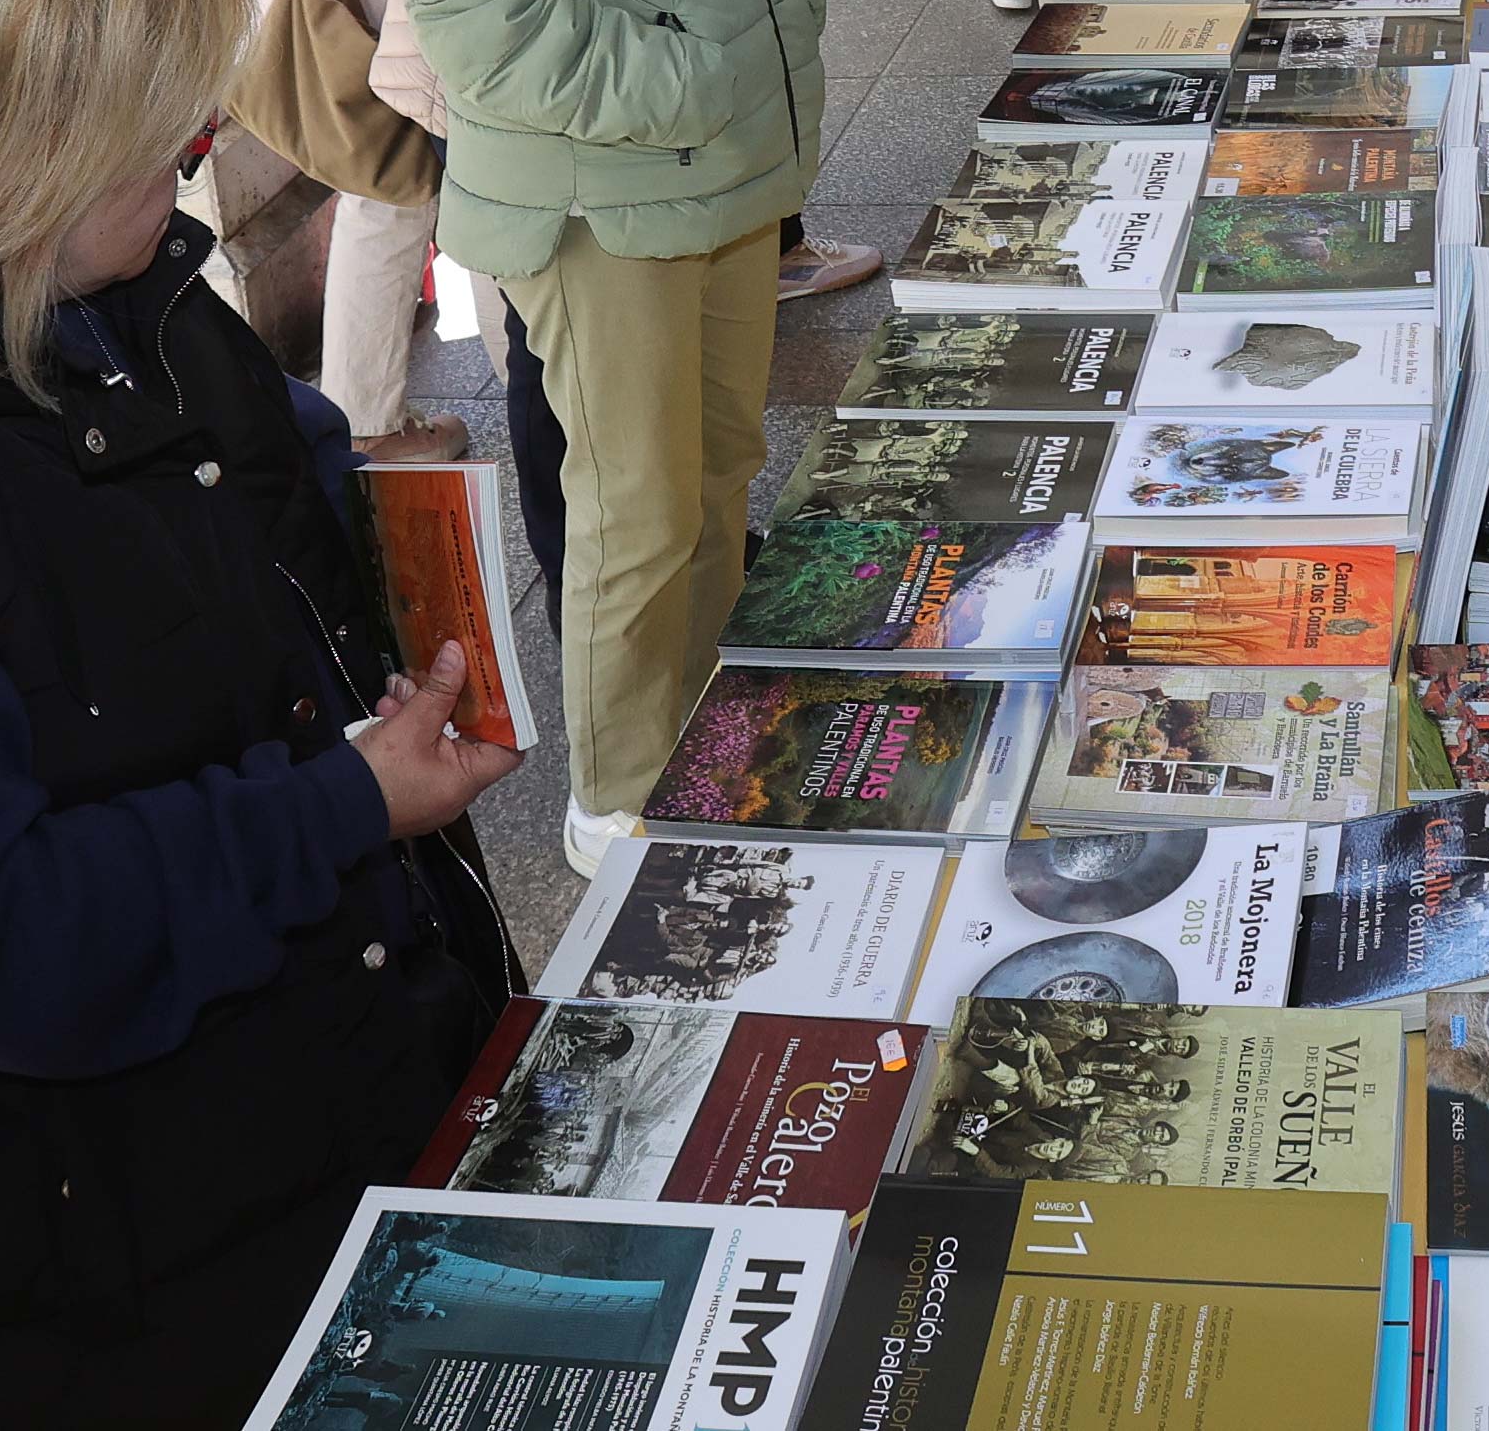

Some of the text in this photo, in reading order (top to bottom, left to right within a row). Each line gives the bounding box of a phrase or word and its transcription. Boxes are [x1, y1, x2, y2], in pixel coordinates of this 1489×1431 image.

[1171, 78, 1203, 116] EL CANAL
[1108, 212, 1151, 274] PALENCIA
[1069, 327, 1116, 393] PALENCIA
[1018, 436, 1071, 515] PALENCIA
[1331, 428, 1362, 501] DE LA CULEBRA
[1352, 428, 1391, 502] LA SIERRA
[884, 544, 924, 624] MONTAÑA PALENTINA
[900, 544, 937, 624] DE USO TRADICIONAL EN LA
[914, 543, 965, 625] PLANTAS
[1303, 561, 1331, 650] de los Condes
[1332, 561, 1354, 614] Carrión
[799, 701, 859, 797] PALENTINOS
[840, 704, 890, 798] DE USO TRADICIONAL EN
[843, 703, 875, 751] PÁRAMOS
[858, 705, 923, 800] PLANTAS
[1312, 718, 1340, 802] y La Braña
[1339, 701, 1366, 777] Santullán
[824, 760, 851, 798] VALLES
[1303, 845, 1319, 882] 10.80
[1424, 817, 1455, 917] Castillos
[826, 872, 880, 999] paréntesis tres (1936-1939)
[852, 869, 906, 989] DIARIO DE GUERRA
[1178, 898, 1207, 945] 2018
[1234, 842, 1280, 995] La Mojonera
[1355, 919, 1370, 962] Palentina
[1406, 870, 1437, 975] de ceniza
[461, 1095, 485, 1123] aruz
[729, 1037, 802, 1191] Historia de la minería en el Valle de
[807, 1057, 878, 1143] Pozo
[849, 1086, 871, 1102] El
[961, 1112, 976, 1136] aruz
[1200, 1035, 1230, 1175] JOSÉ SIERRA ÁLVAREZ FERNANDO
[1221, 1036, 1257, 1187] VALLEJO DE ORBÓ (PAL
[1245, 1035, 1275, 1173] HISTORIA DE LA COLONIA
[1272, 1045, 1321, 1190] DE LOS SUEÑ
[1317, 1036, 1361, 1148] VALLE
[1362, 1082, 1376, 1099] EL
[1026, 1199, 1096, 1254] 11
[1034, 1201, 1077, 1212] NÚMERO
[685, 1228, 743, 1382] COLECCIÓN HISTORIA DE LA
[889, 1235, 935, 1338] montaña
[911, 1236, 959, 1354] colección
[1095, 1299, 1116, 1352] Jorge Ibáñez
[332, 1326, 358, 1359] aruz
[708, 1257, 807, 1417] HMP
